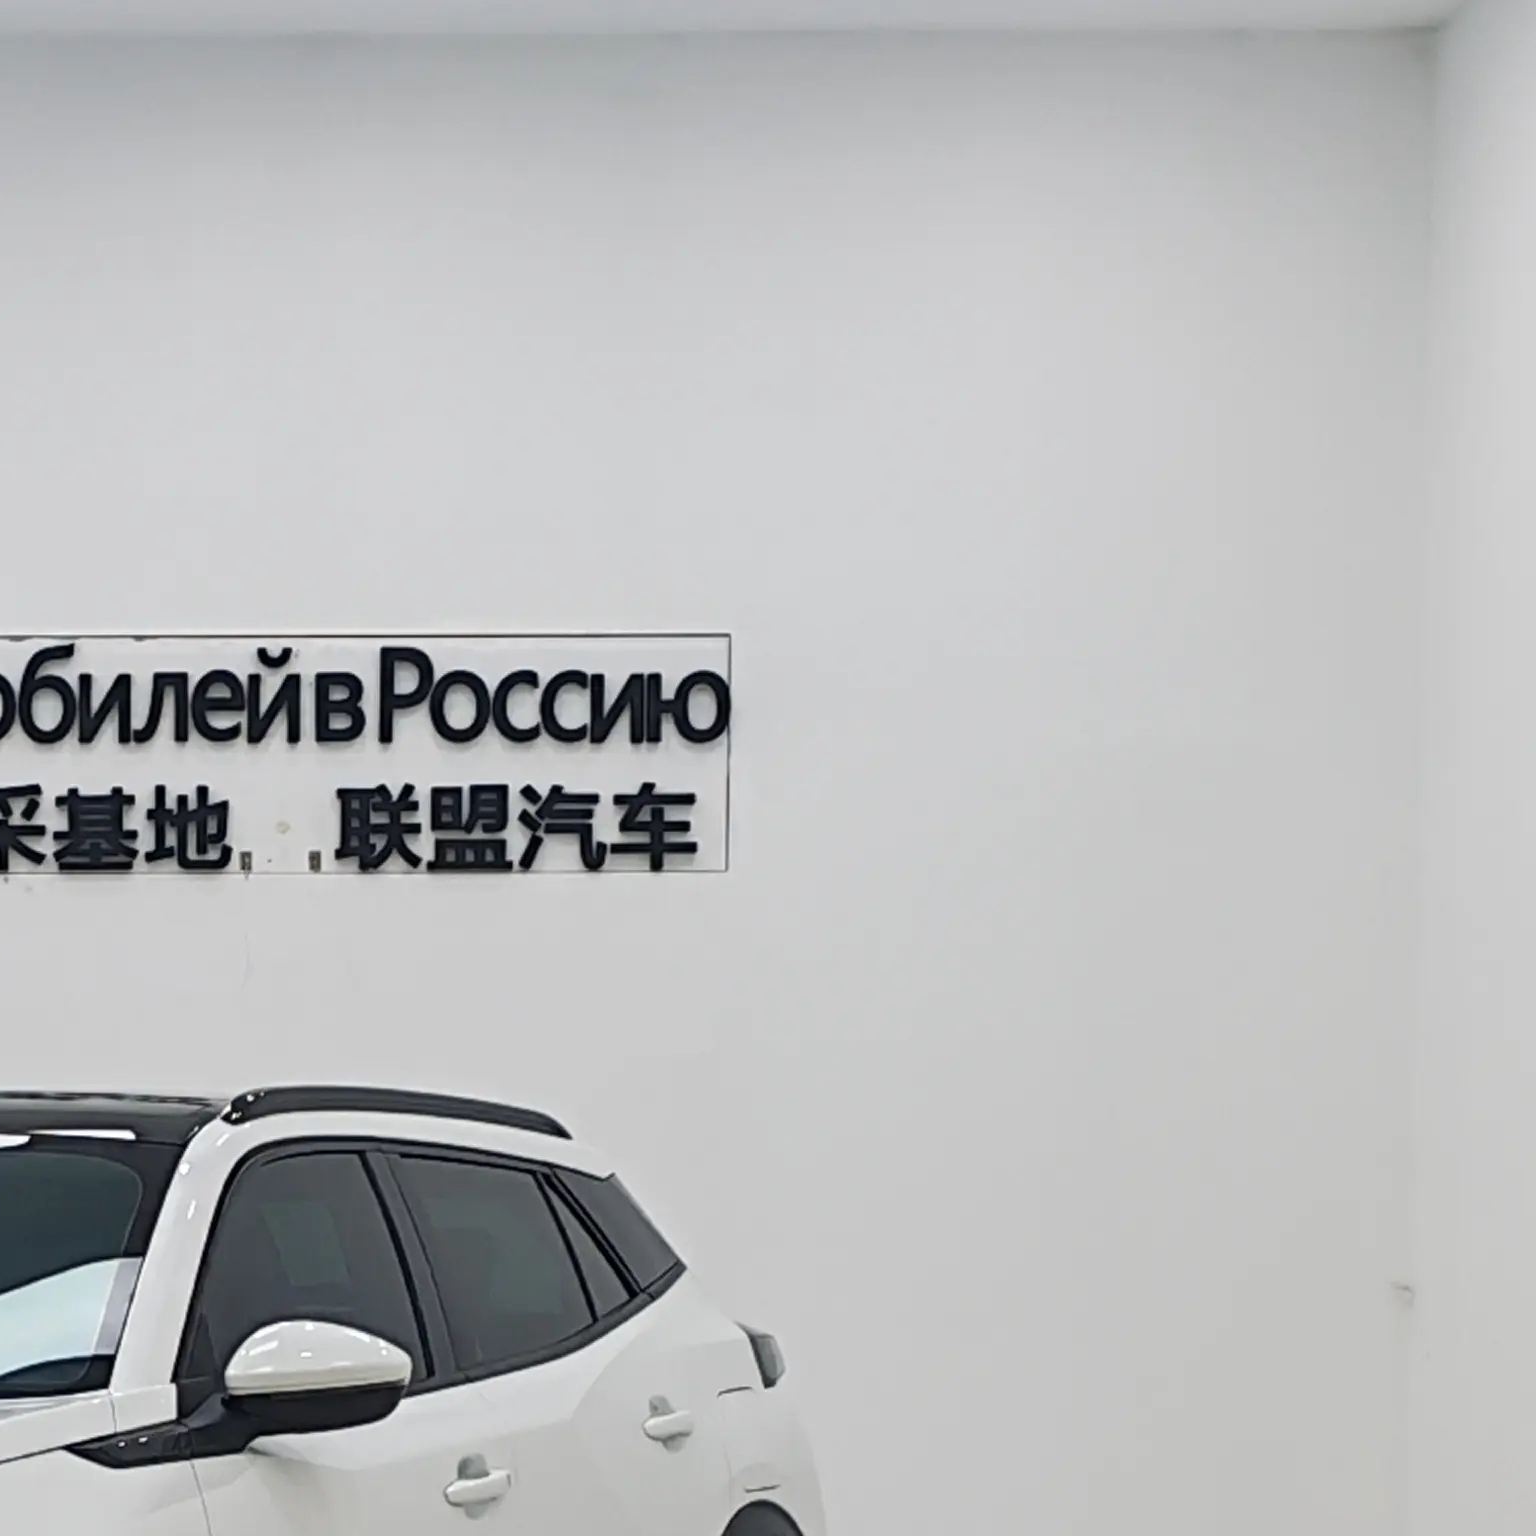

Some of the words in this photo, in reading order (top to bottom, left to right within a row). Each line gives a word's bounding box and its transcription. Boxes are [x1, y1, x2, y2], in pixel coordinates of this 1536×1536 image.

[315, 673, 366, 743] в
[379, 647, 731, 745] Россию
[335, 783, 698, 872] 联盟汽车
